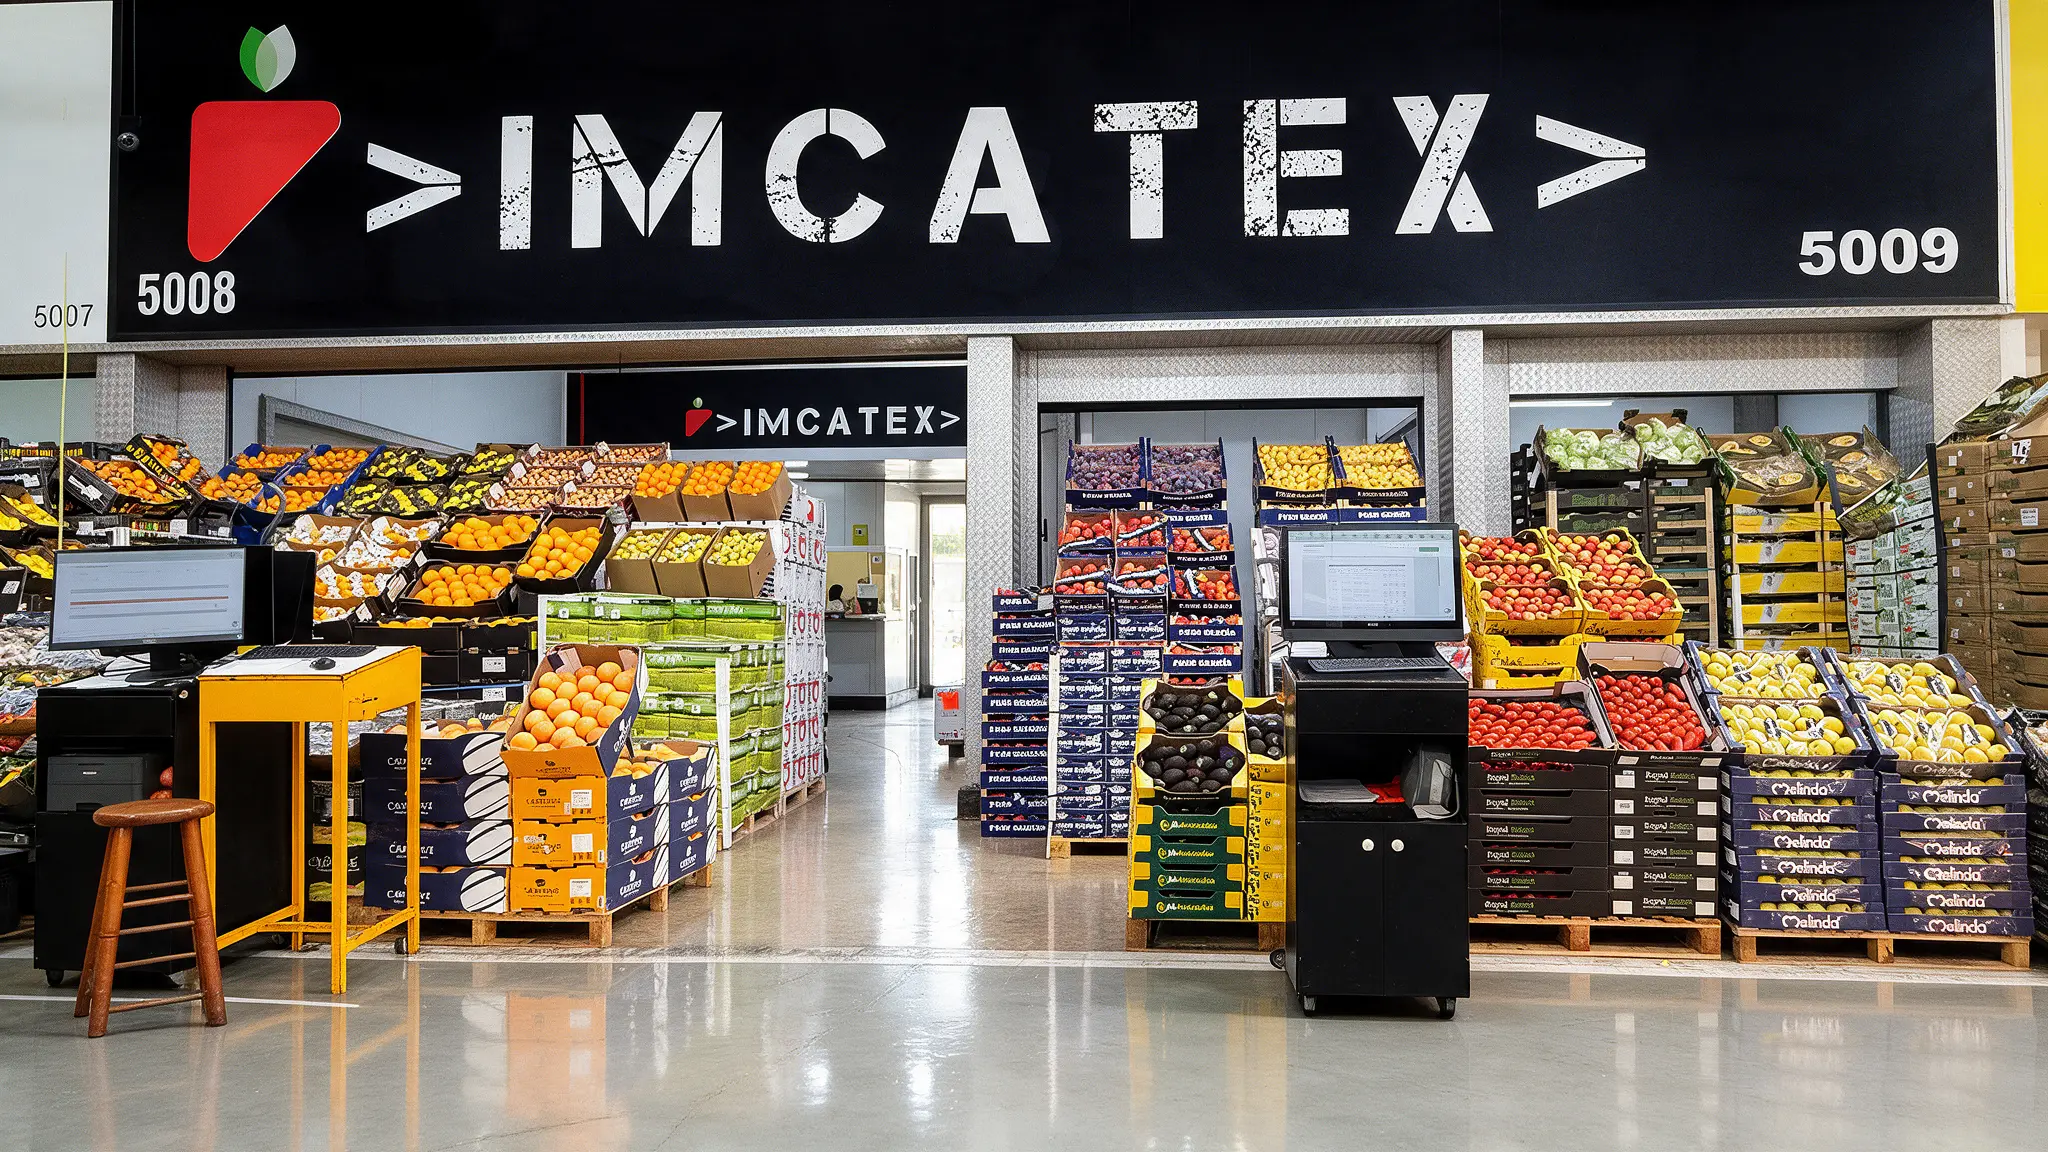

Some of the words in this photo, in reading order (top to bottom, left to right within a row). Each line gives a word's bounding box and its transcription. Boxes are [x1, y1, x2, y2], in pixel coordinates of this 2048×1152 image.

[1799, 227, 1959, 276] 5009
[137, 271, 236, 316] 5008
[34, 304, 94, 329] 5007
